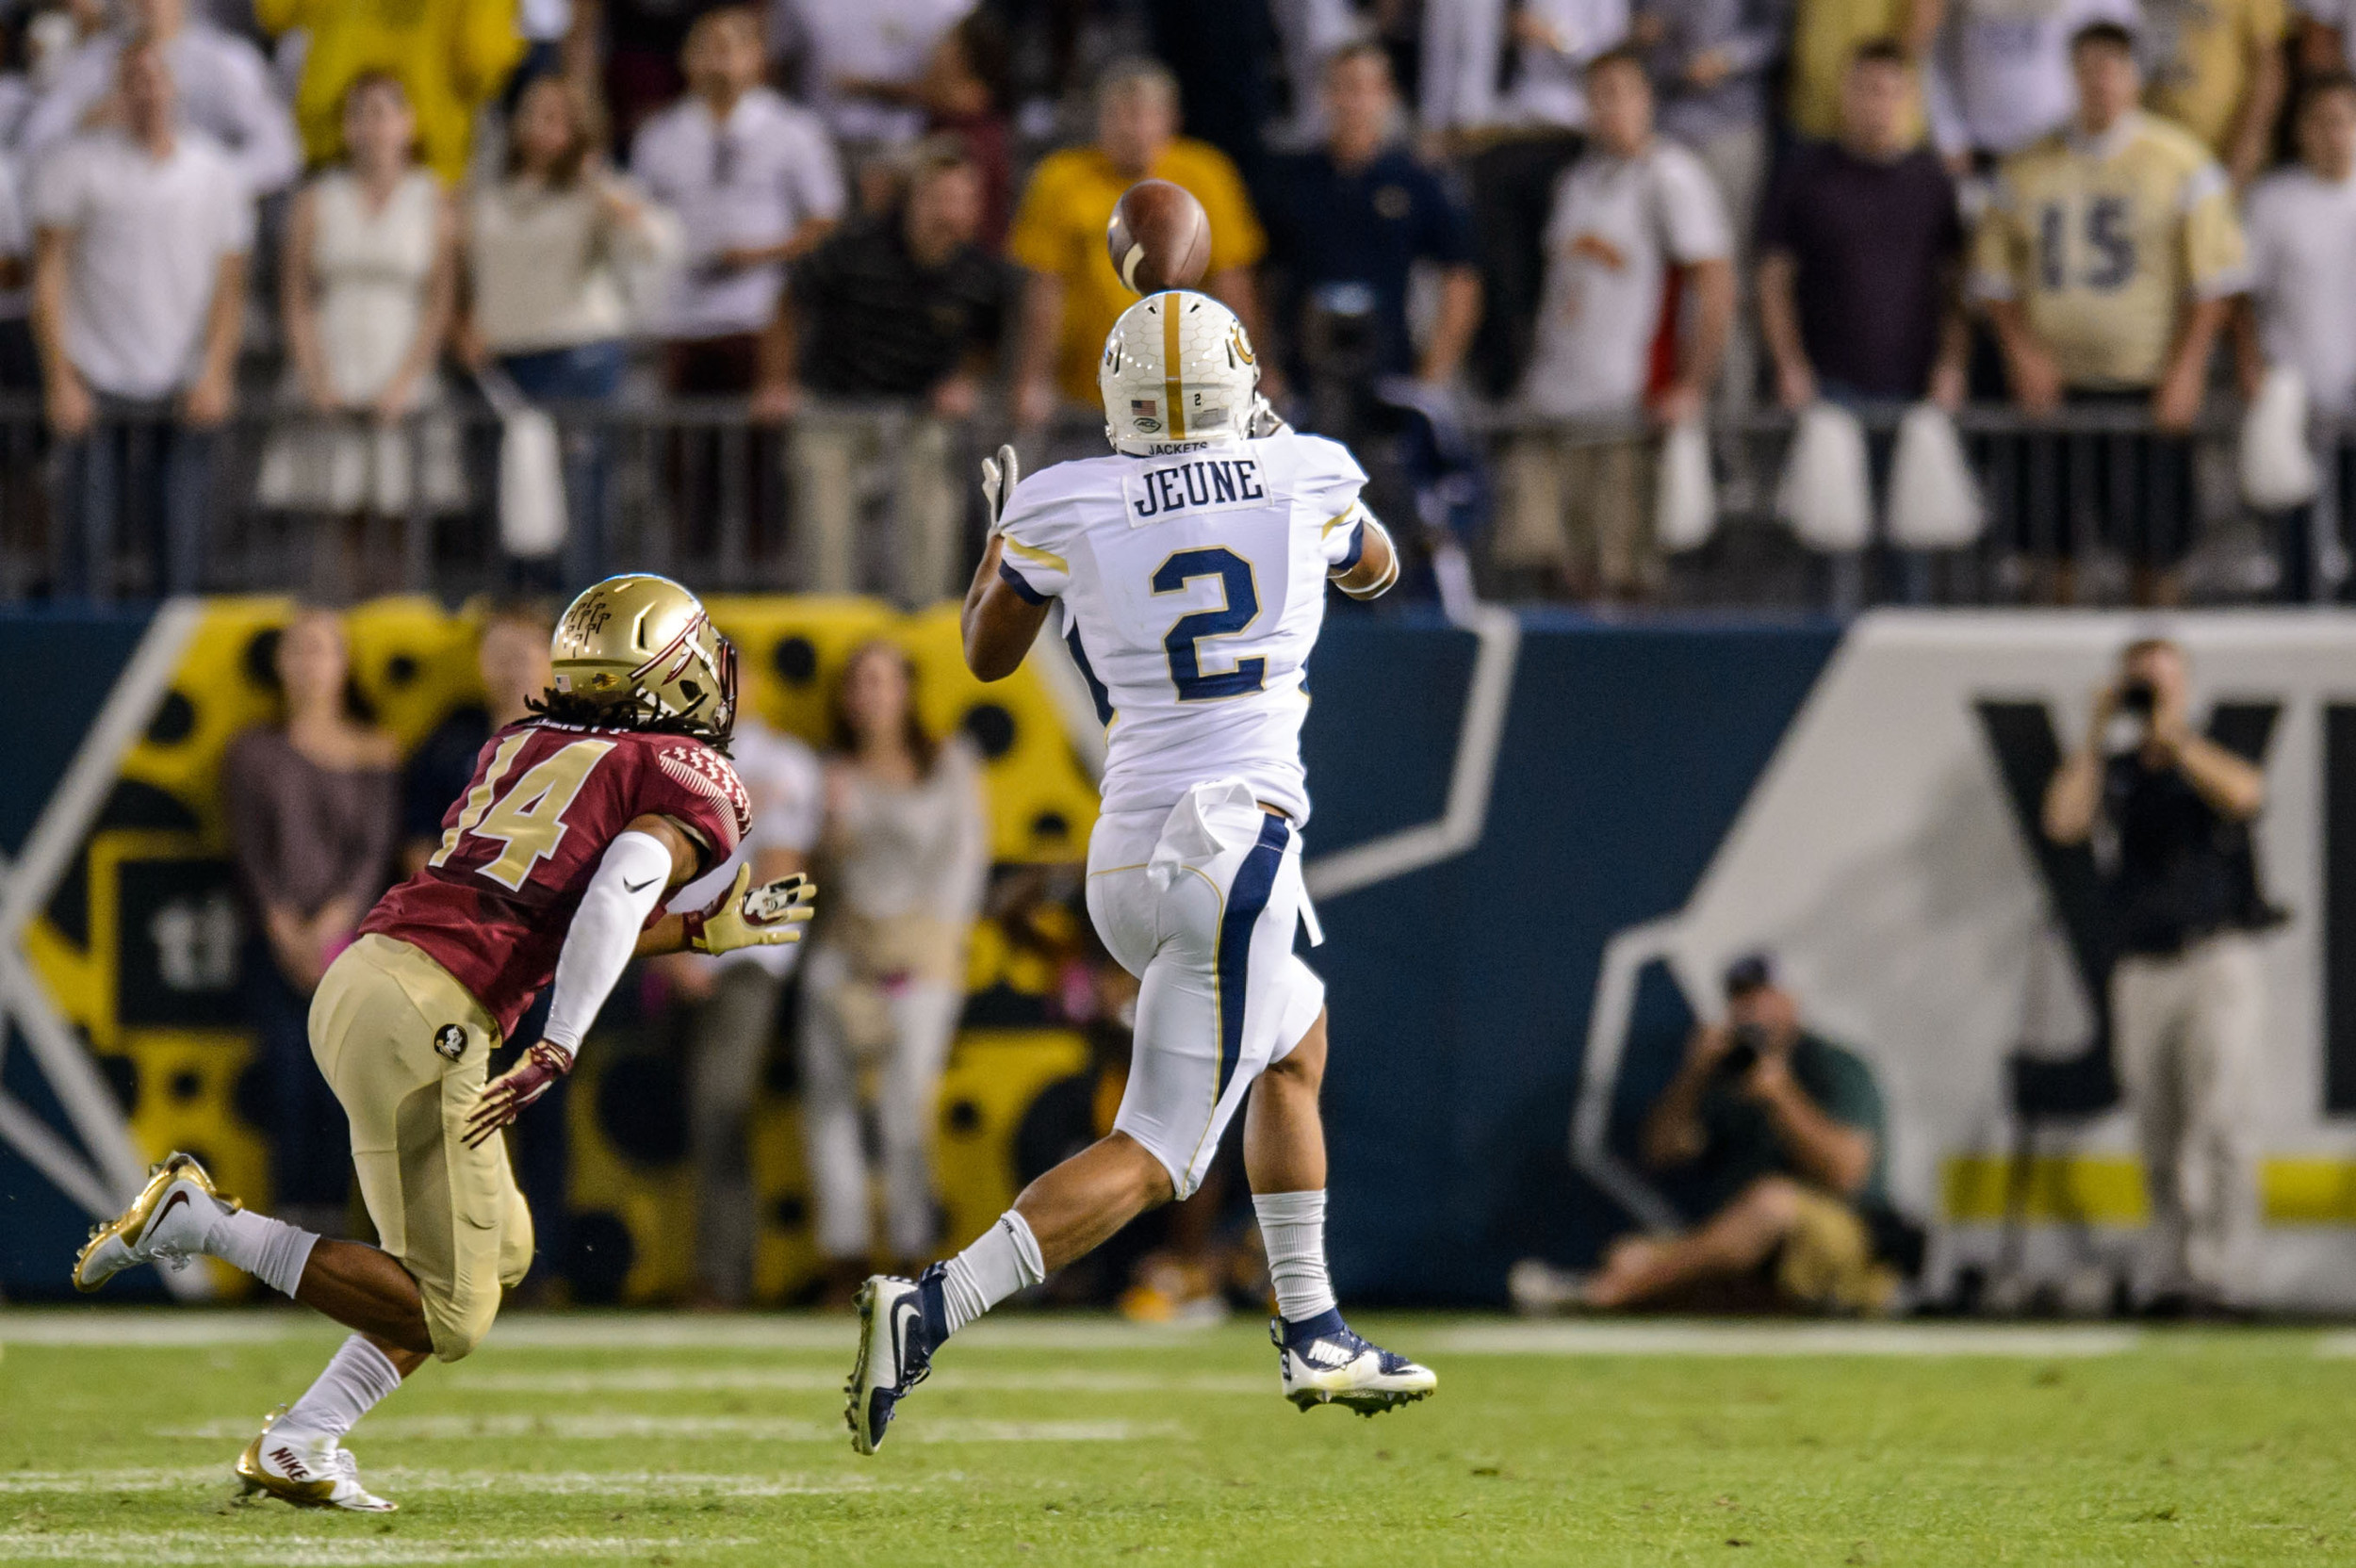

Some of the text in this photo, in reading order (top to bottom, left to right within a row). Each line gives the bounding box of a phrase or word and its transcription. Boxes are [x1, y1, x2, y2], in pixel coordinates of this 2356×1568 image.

[2037, 195, 2137, 294] 15
[1194, 393, 1202, 406] 2
[1149, 442, 1207, 455] JACKETS
[1135, 460, 1264, 516] JEUNE
[1150, 545, 1268, 704] 2
[428, 726, 618, 893] 14
[269, 1447, 310, 1483] NIKE
